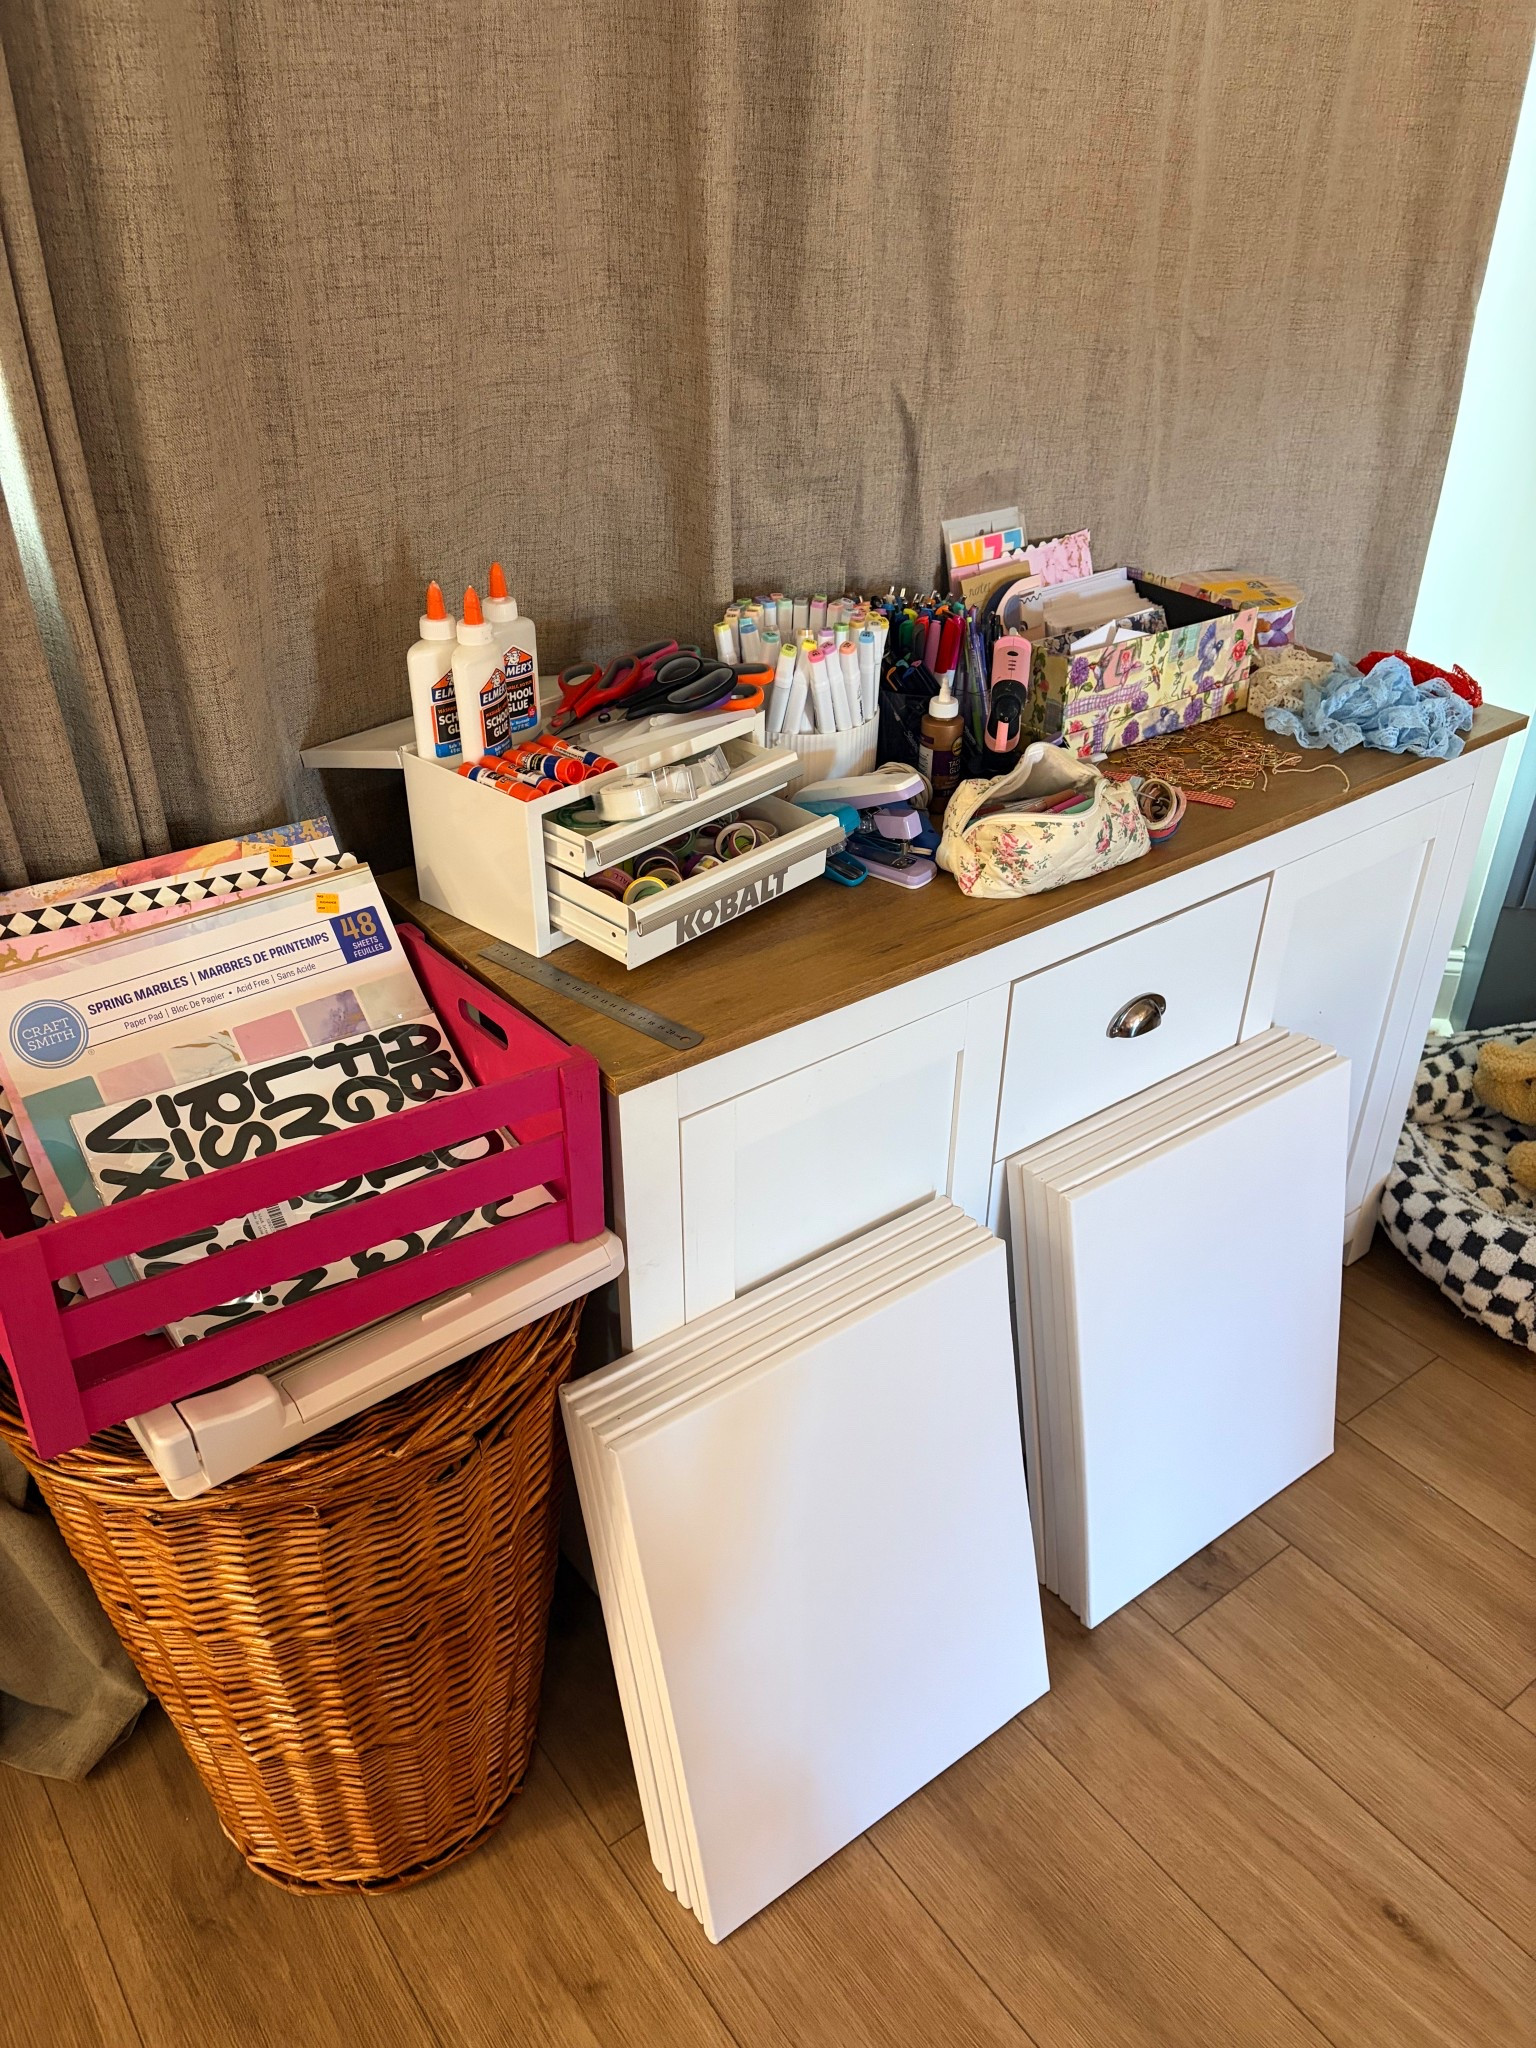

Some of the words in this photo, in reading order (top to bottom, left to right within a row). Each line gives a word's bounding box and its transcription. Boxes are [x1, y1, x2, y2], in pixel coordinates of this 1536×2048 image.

[676, 866, 790, 946] KOBALT
[339, 911, 377, 941] 48
[352, 936, 380, 951] SHEETS
[353, 942, 385, 959] FEUILLES
[197, 956, 253, 982] MARBRES
[253, 950, 269, 965] DE
[270, 931, 331, 960] PRINTEMPS
[276, 969, 296, 982] Sans
[296, 962, 317, 977] Acide
[87, 992, 134, 1017] SPRING
[133, 974, 190, 1002] MARBLES
[236, 978, 253, 995] Acid
[253, 976, 270, 990] Free
[170, 1002, 189, 1016] Bloc
[189, 998, 201, 1010] De
[200, 989, 226, 1008] Papier
[21, 1016, 71, 1041] CRAFT
[124, 1015, 148, 1031] Paper
[148, 1010, 164, 1024] Pad
[27, 1028, 77, 1053] SMITH
